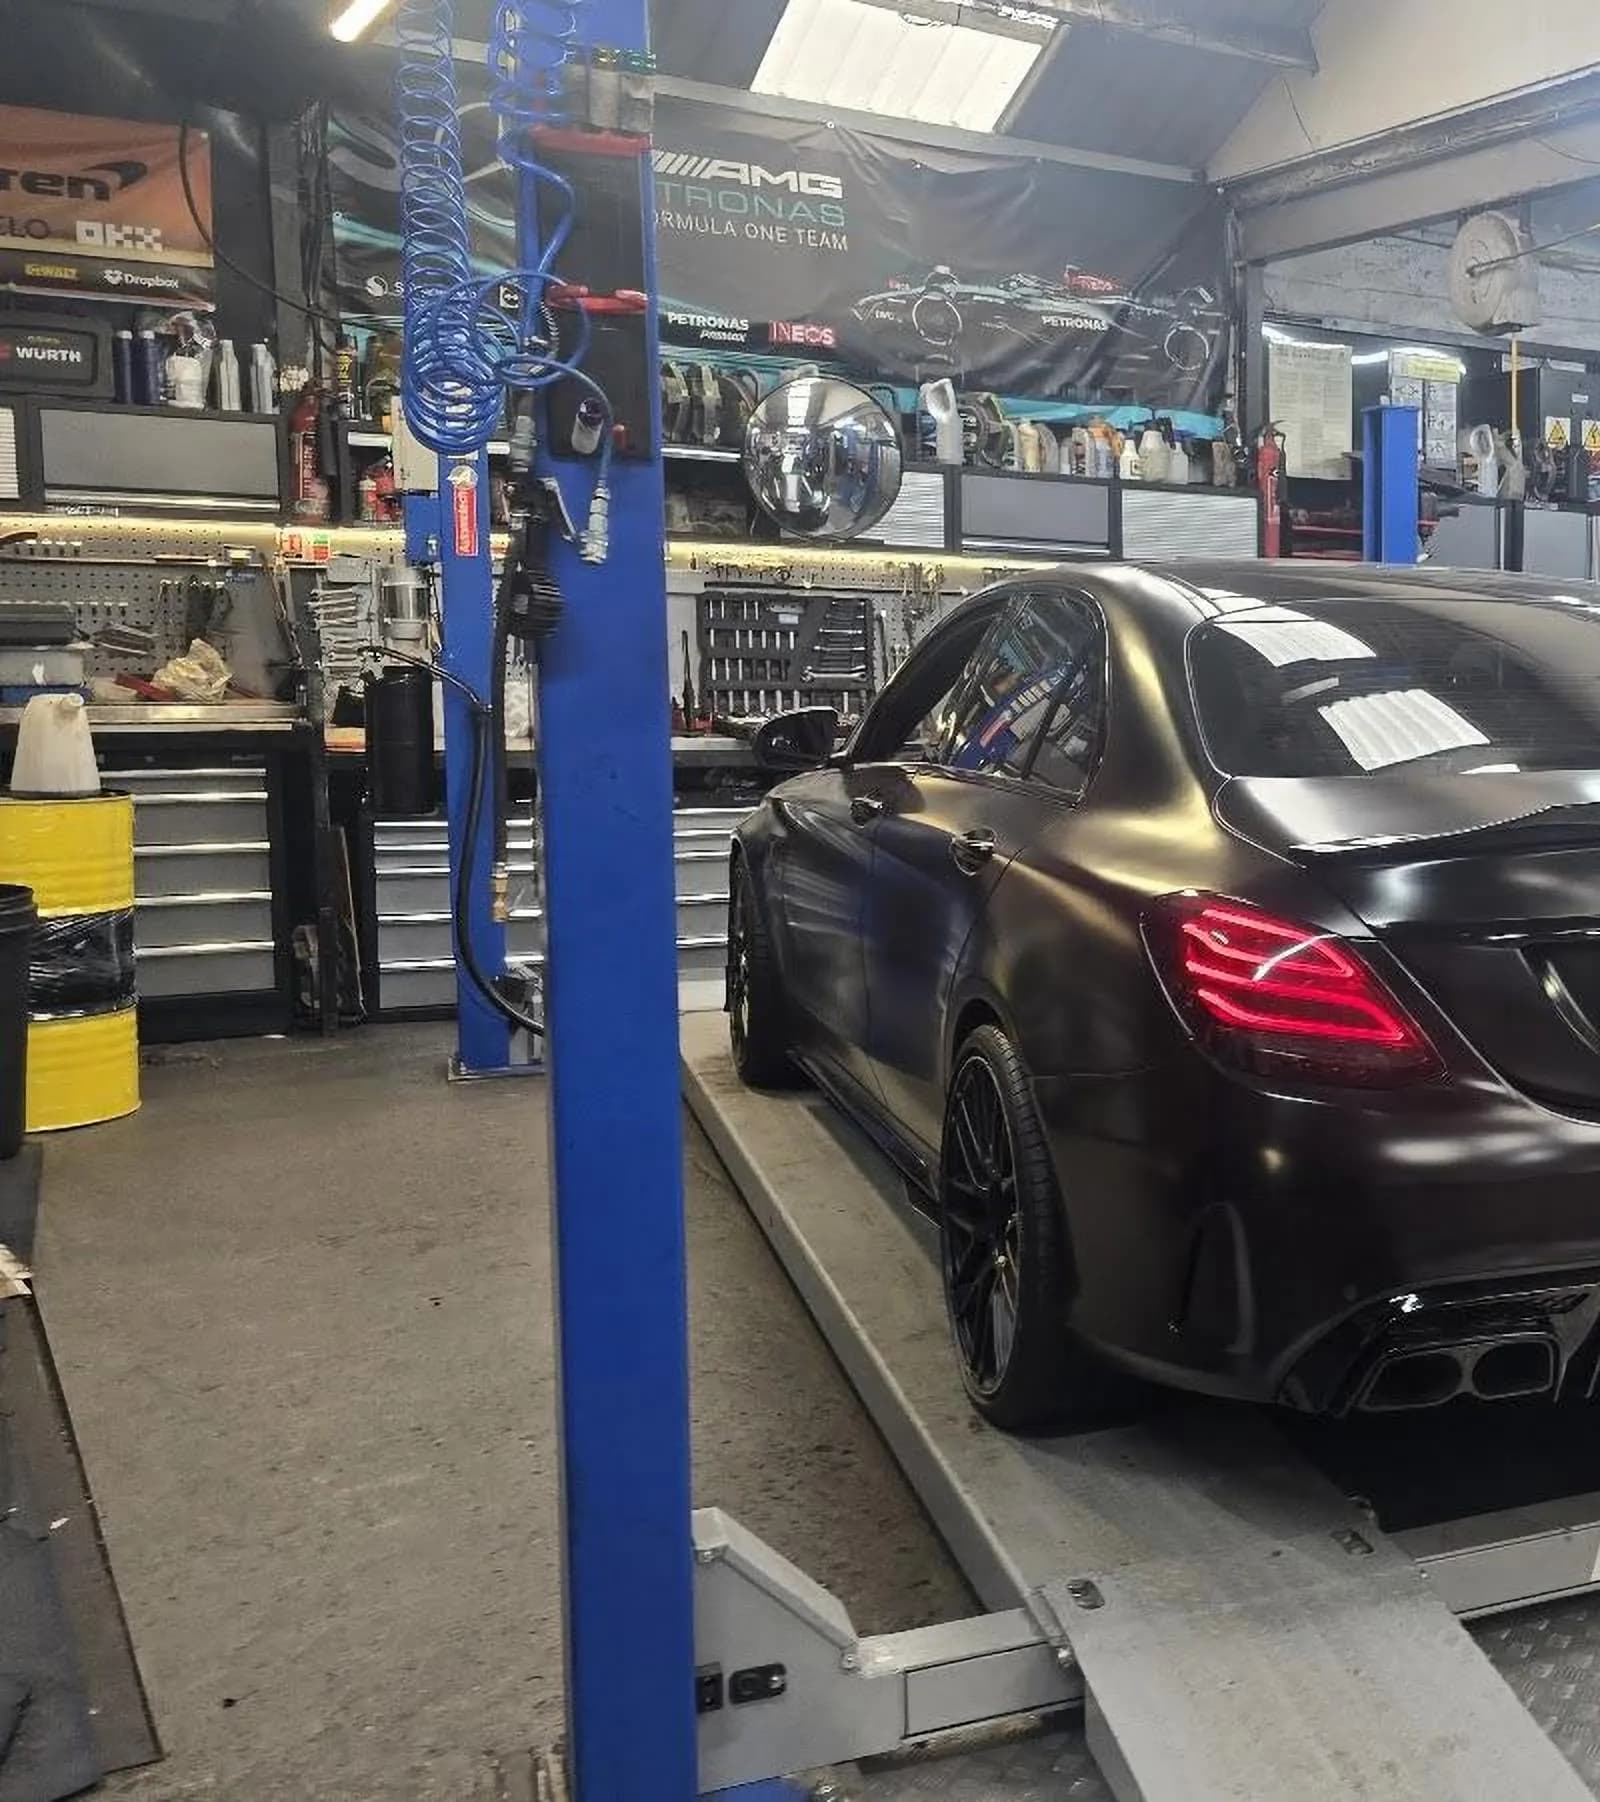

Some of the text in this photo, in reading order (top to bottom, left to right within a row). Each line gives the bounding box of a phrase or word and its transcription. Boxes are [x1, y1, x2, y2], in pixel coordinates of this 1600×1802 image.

[699, 158, 844, 199] AMG
[75, 219, 164, 253] OKX
[744, 222, 788, 244] ONE
[794, 228, 850, 251] TEAM
[123, 272, 180, 290] Dropbox
[667, 310, 750, 332] PETRONAS
[770, 320, 836, 347] INEOS
[1040, 314, 1111, 332] PETRONAS
